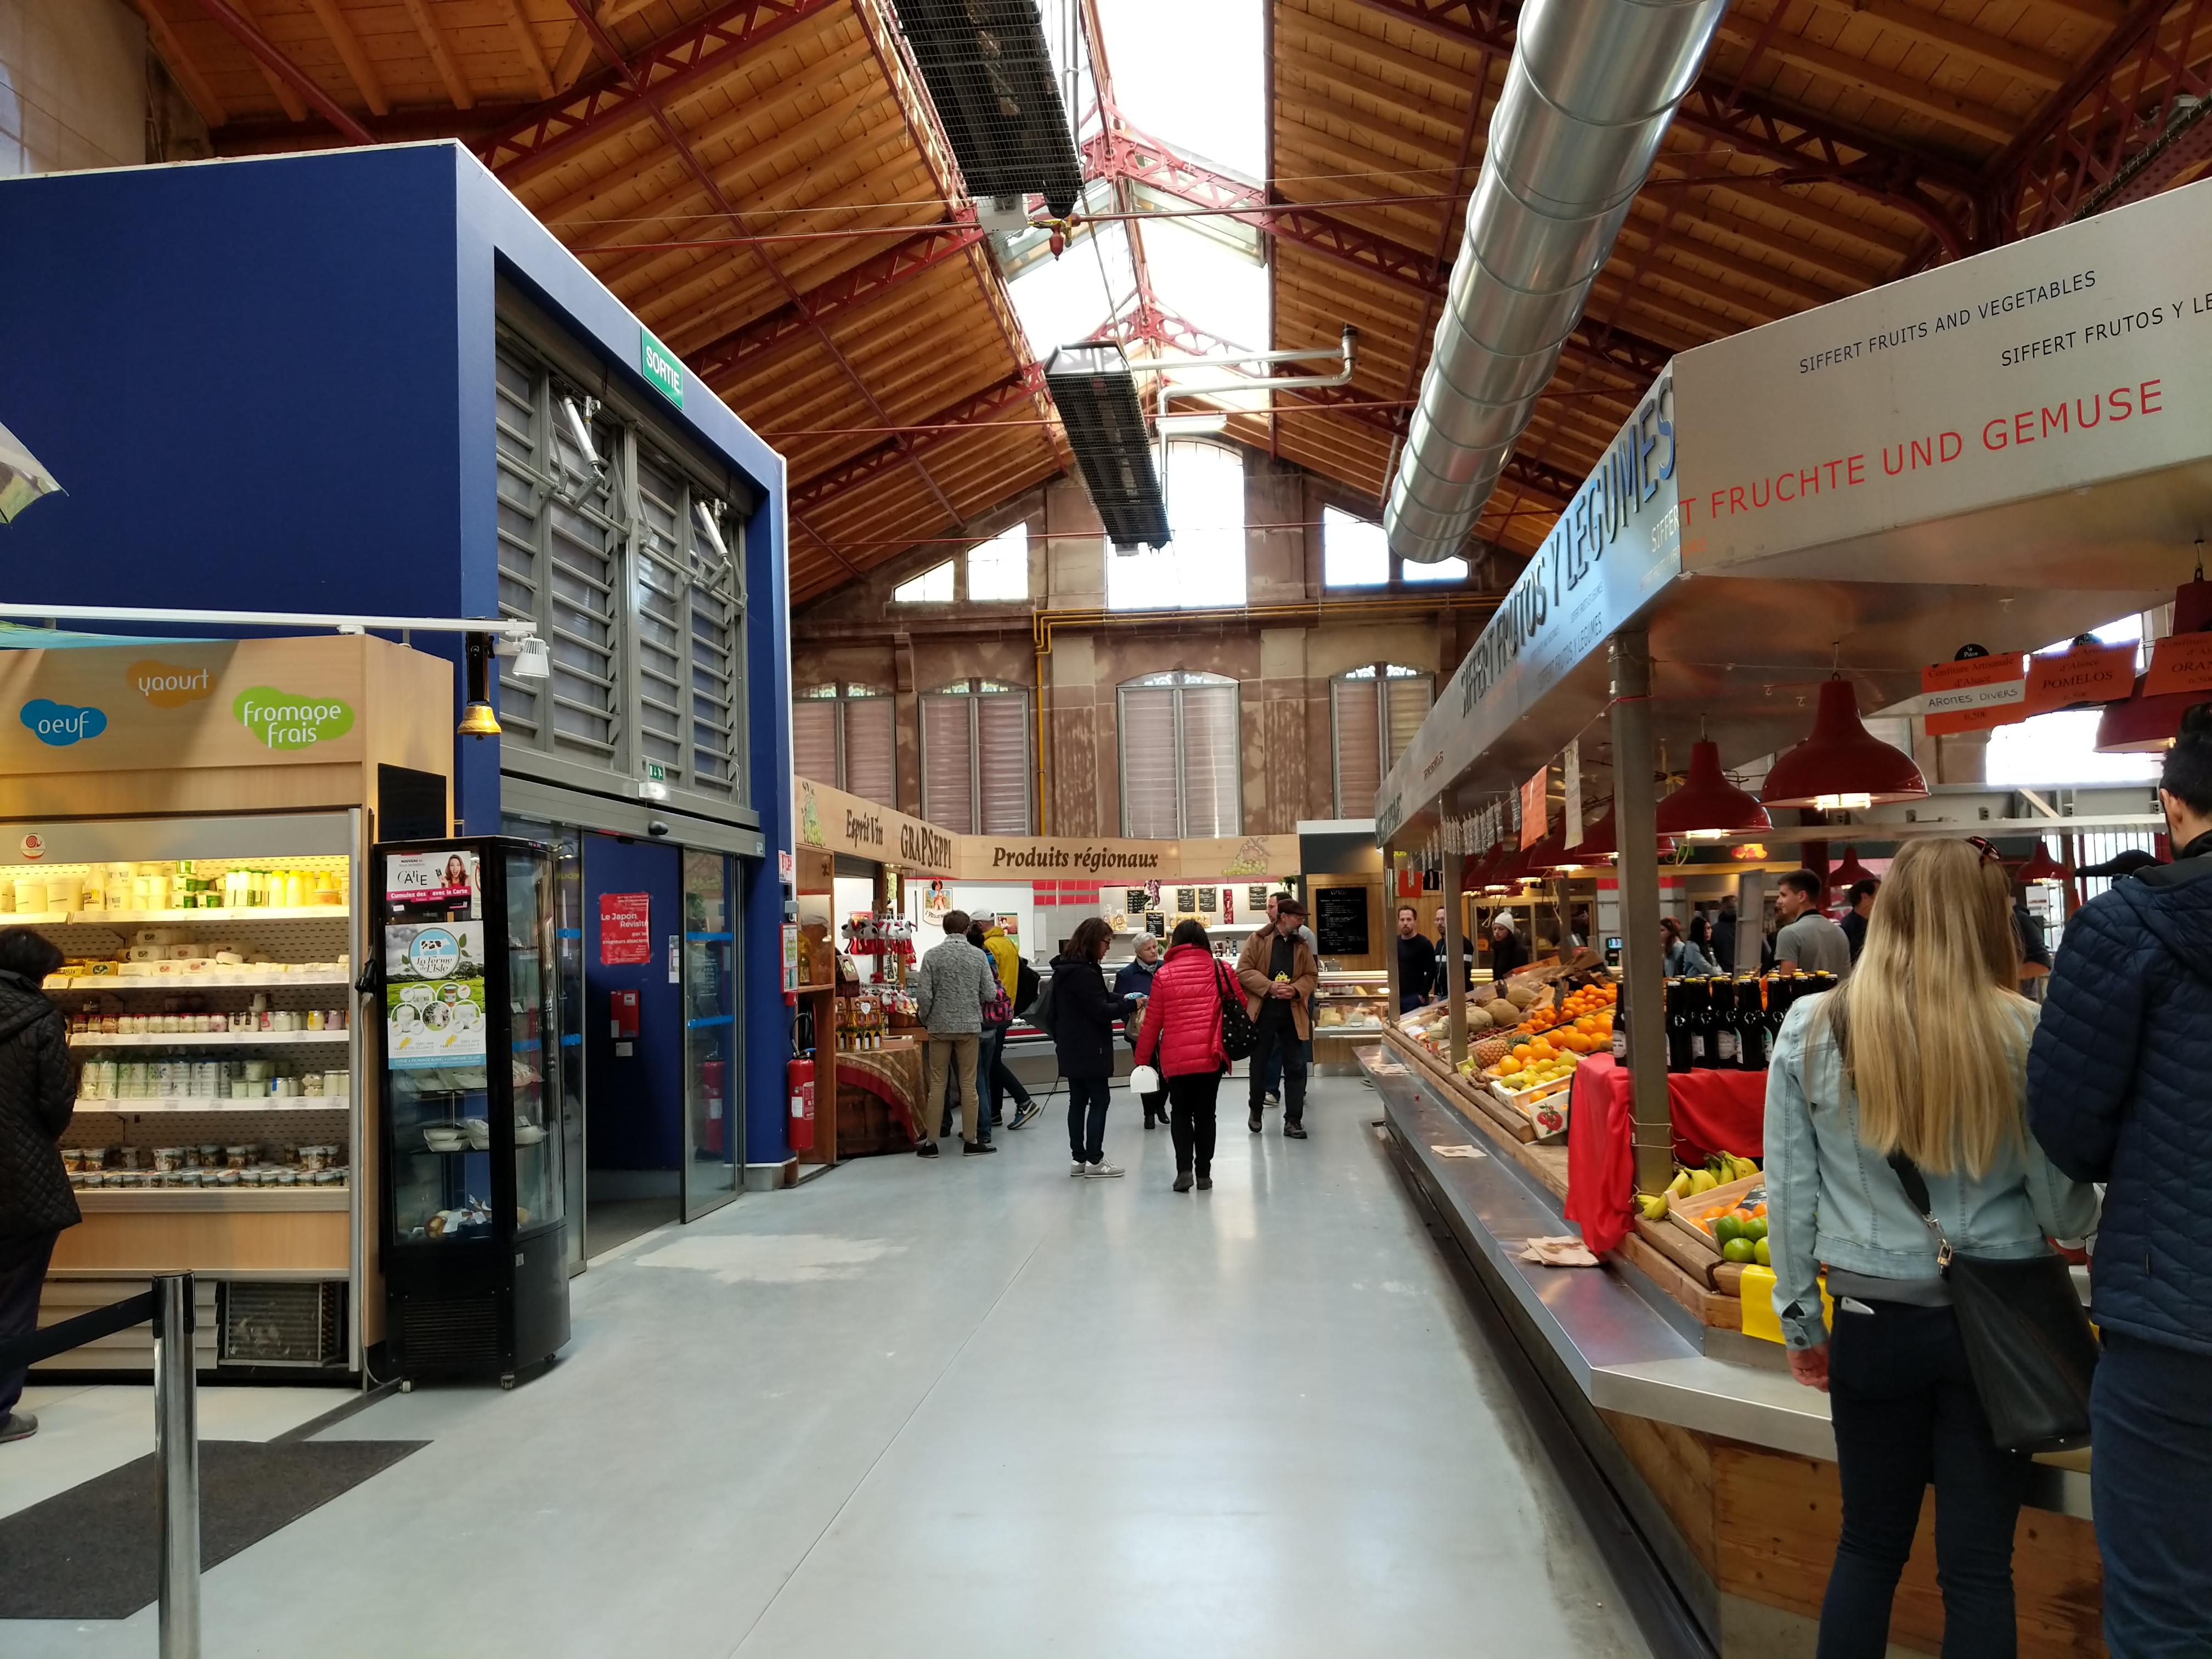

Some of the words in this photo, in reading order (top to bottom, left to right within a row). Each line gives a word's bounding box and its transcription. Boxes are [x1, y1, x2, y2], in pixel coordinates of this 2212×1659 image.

[1800, 342, 1863, 374] SIFFERT
[1869, 321, 1928, 353] FRUITS
[1935, 309, 1970, 333] AND
[1978, 270, 2096, 319] VEGETABLES
[2001, 331, 2076, 366] SIFFERT
[2085, 307, 2163, 343] FRUTOS
[2171, 300, 2184, 319] Y
[646, 345, 680, 394] SORTIE
[1712, 454, 1865, 518] FRUCHTE
[1883, 431, 1963, 476] UND
[1982, 379, 2163, 451] GEMUSE
[1460, 627, 1495, 718] SIFFERT
[1496, 556, 1547, 675] FRUTOS
[1550, 532, 1560, 607] Y
[1564, 376, 1675, 591] LEGUMES
[1578, 612, 1602, 653] LEGUMES
[138, 668, 210, 697] yaourt
[2042, 670, 2113, 690] POMELOS
[1979, 689, 2018, 701] DIVERS
[38, 710, 90, 739] oeuf
[243, 700, 342, 727] fromage
[267, 720, 318, 748] frais
[845, 809, 870, 848] Esprit
[871, 815, 884, 845] Vin
[900, 823, 952, 870] GRAPSEPPI
[992, 845, 1070, 867] Produits
[1074, 847, 1159, 873] régionaux
[612, 913, 637, 921] Japon
[416, 957, 426, 965] La
[426, 956, 453, 965] Ferme
[427, 963, 448, 973] L'Isle
